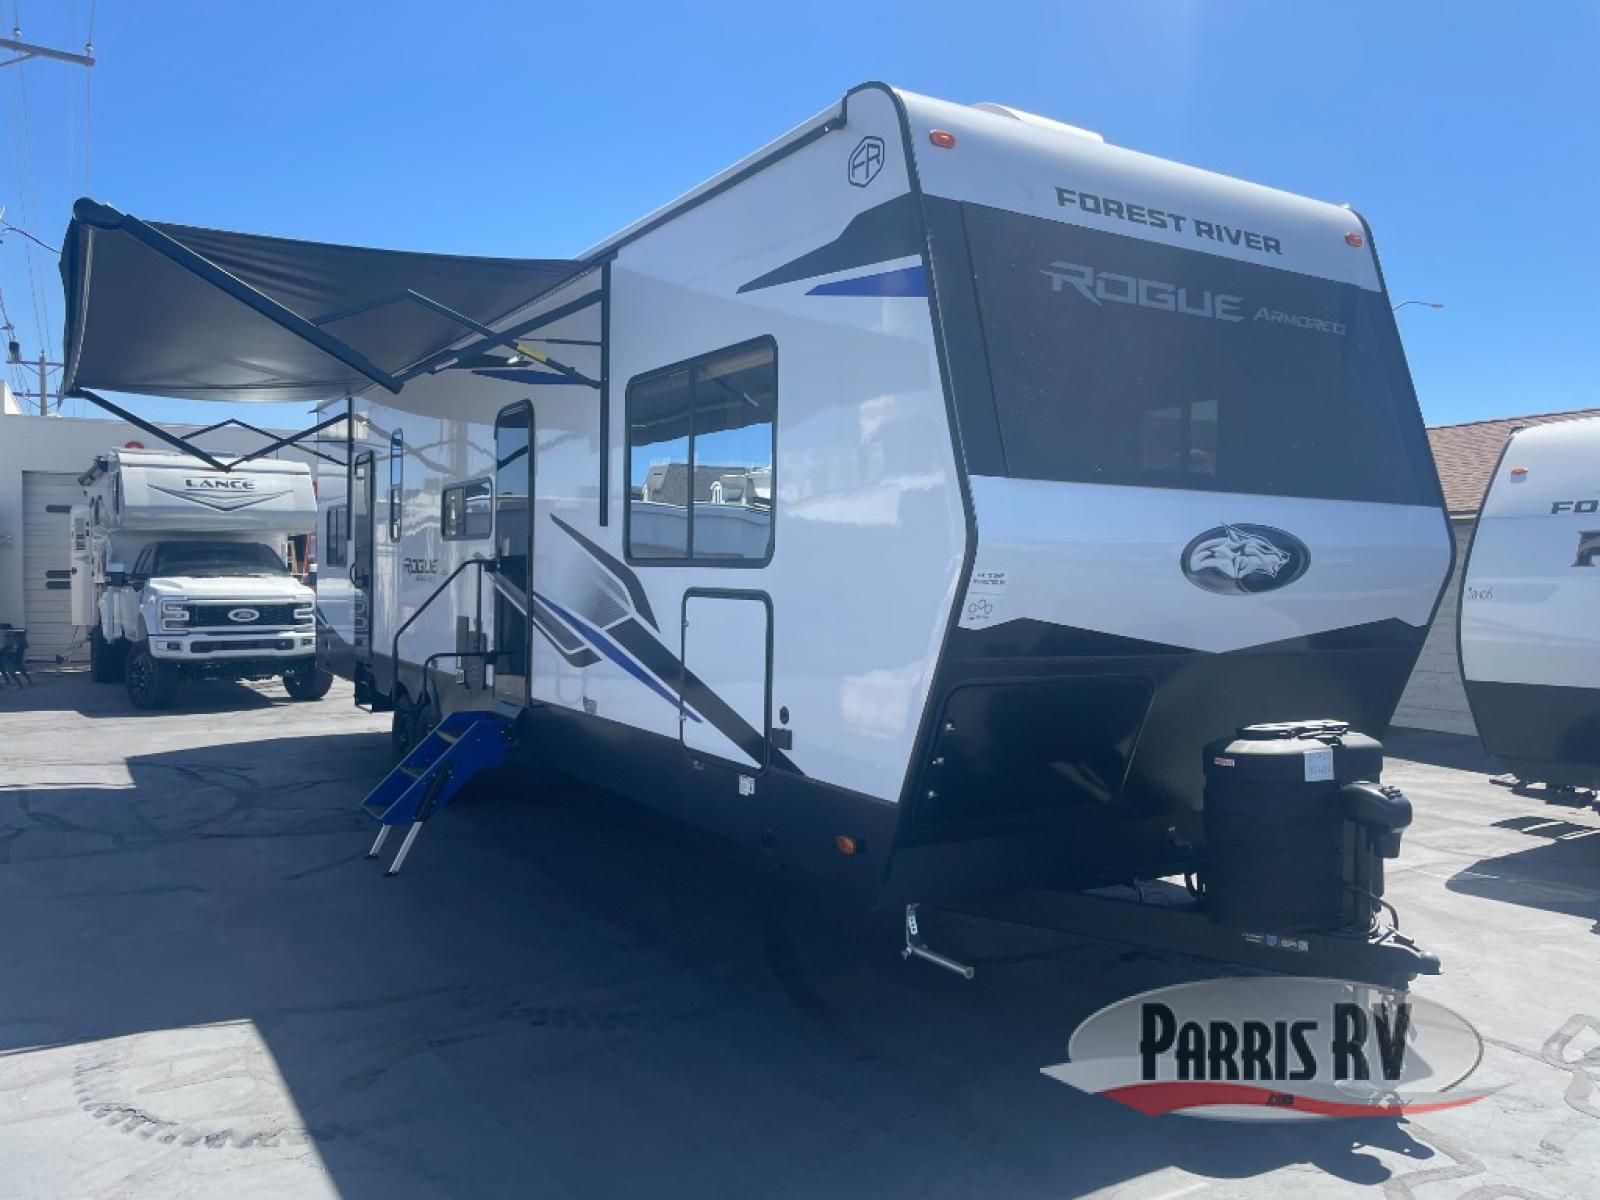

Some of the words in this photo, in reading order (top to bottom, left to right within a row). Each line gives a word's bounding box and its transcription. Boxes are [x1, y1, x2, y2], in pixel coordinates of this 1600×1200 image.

[1055, 186, 1186, 233] FOREST
[1192, 218, 1282, 255] RIVER
[1039, 260, 1245, 323] ROGUE
[1254, 306, 1347, 336] ARMORED
[184, 479, 256, 490] LANCE
